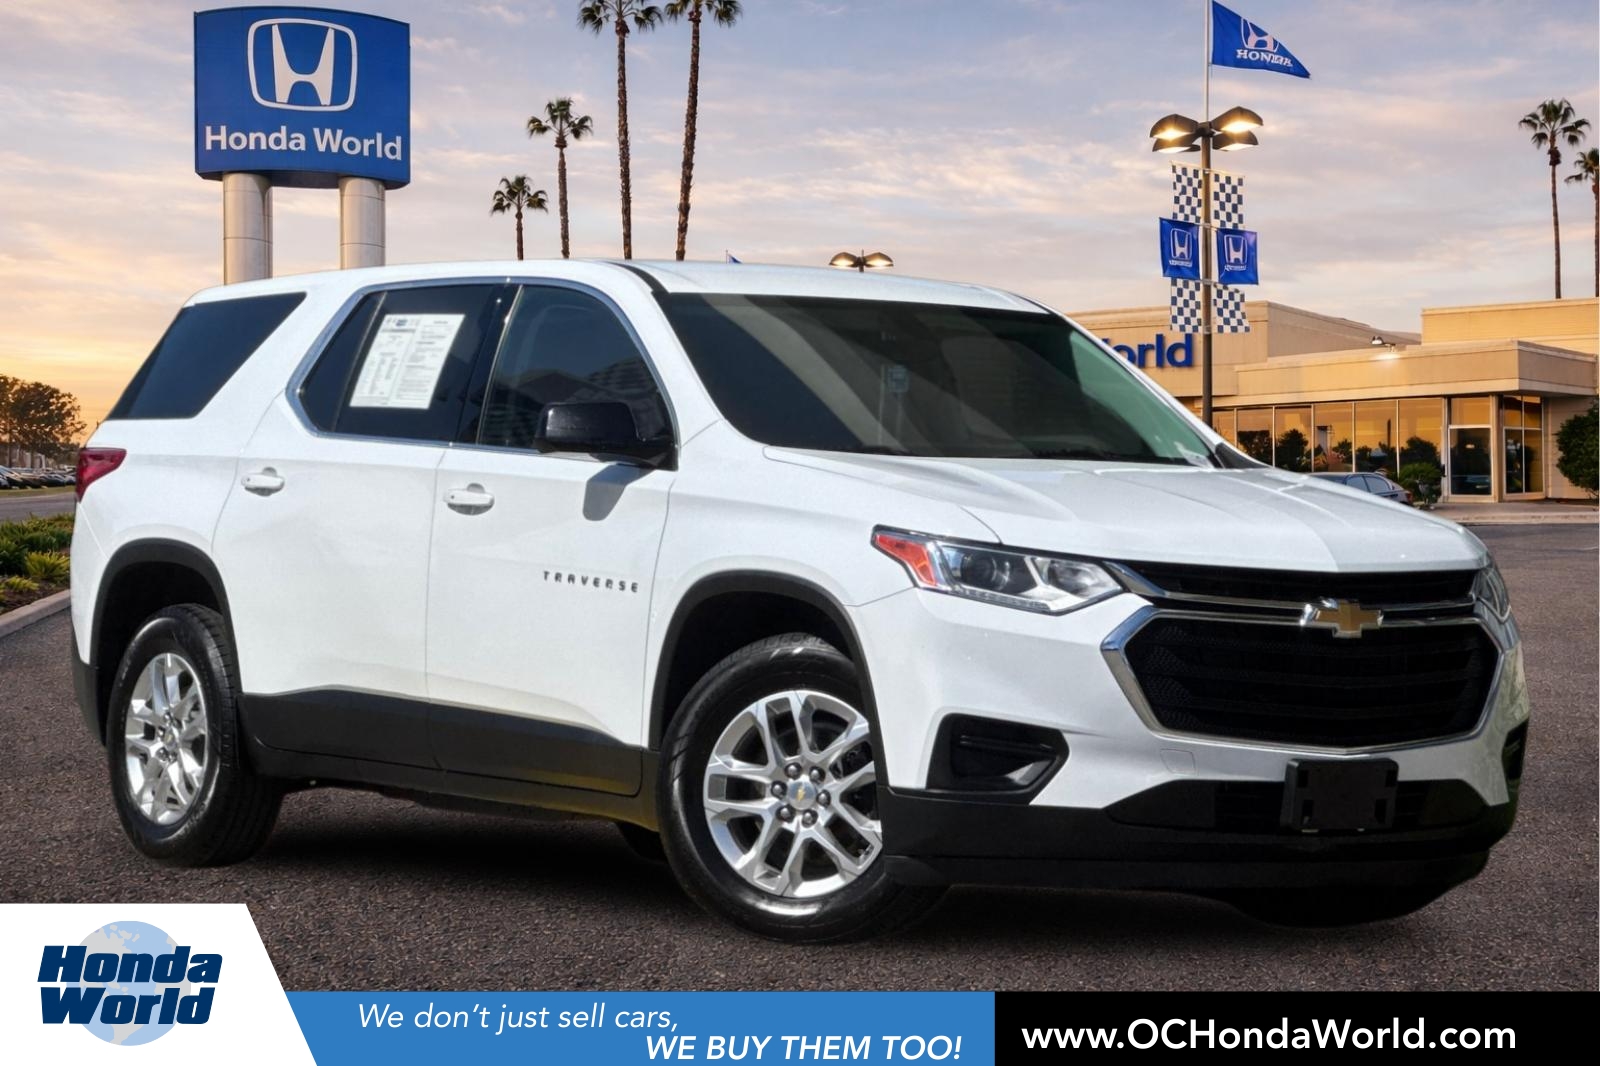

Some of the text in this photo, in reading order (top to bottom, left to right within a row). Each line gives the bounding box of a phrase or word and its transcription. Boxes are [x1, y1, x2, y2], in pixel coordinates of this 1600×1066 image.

[205, 125, 402, 161] Honda World
[1101, 333, 1194, 368] orld
[543, 570, 639, 593] TRAVERSE
